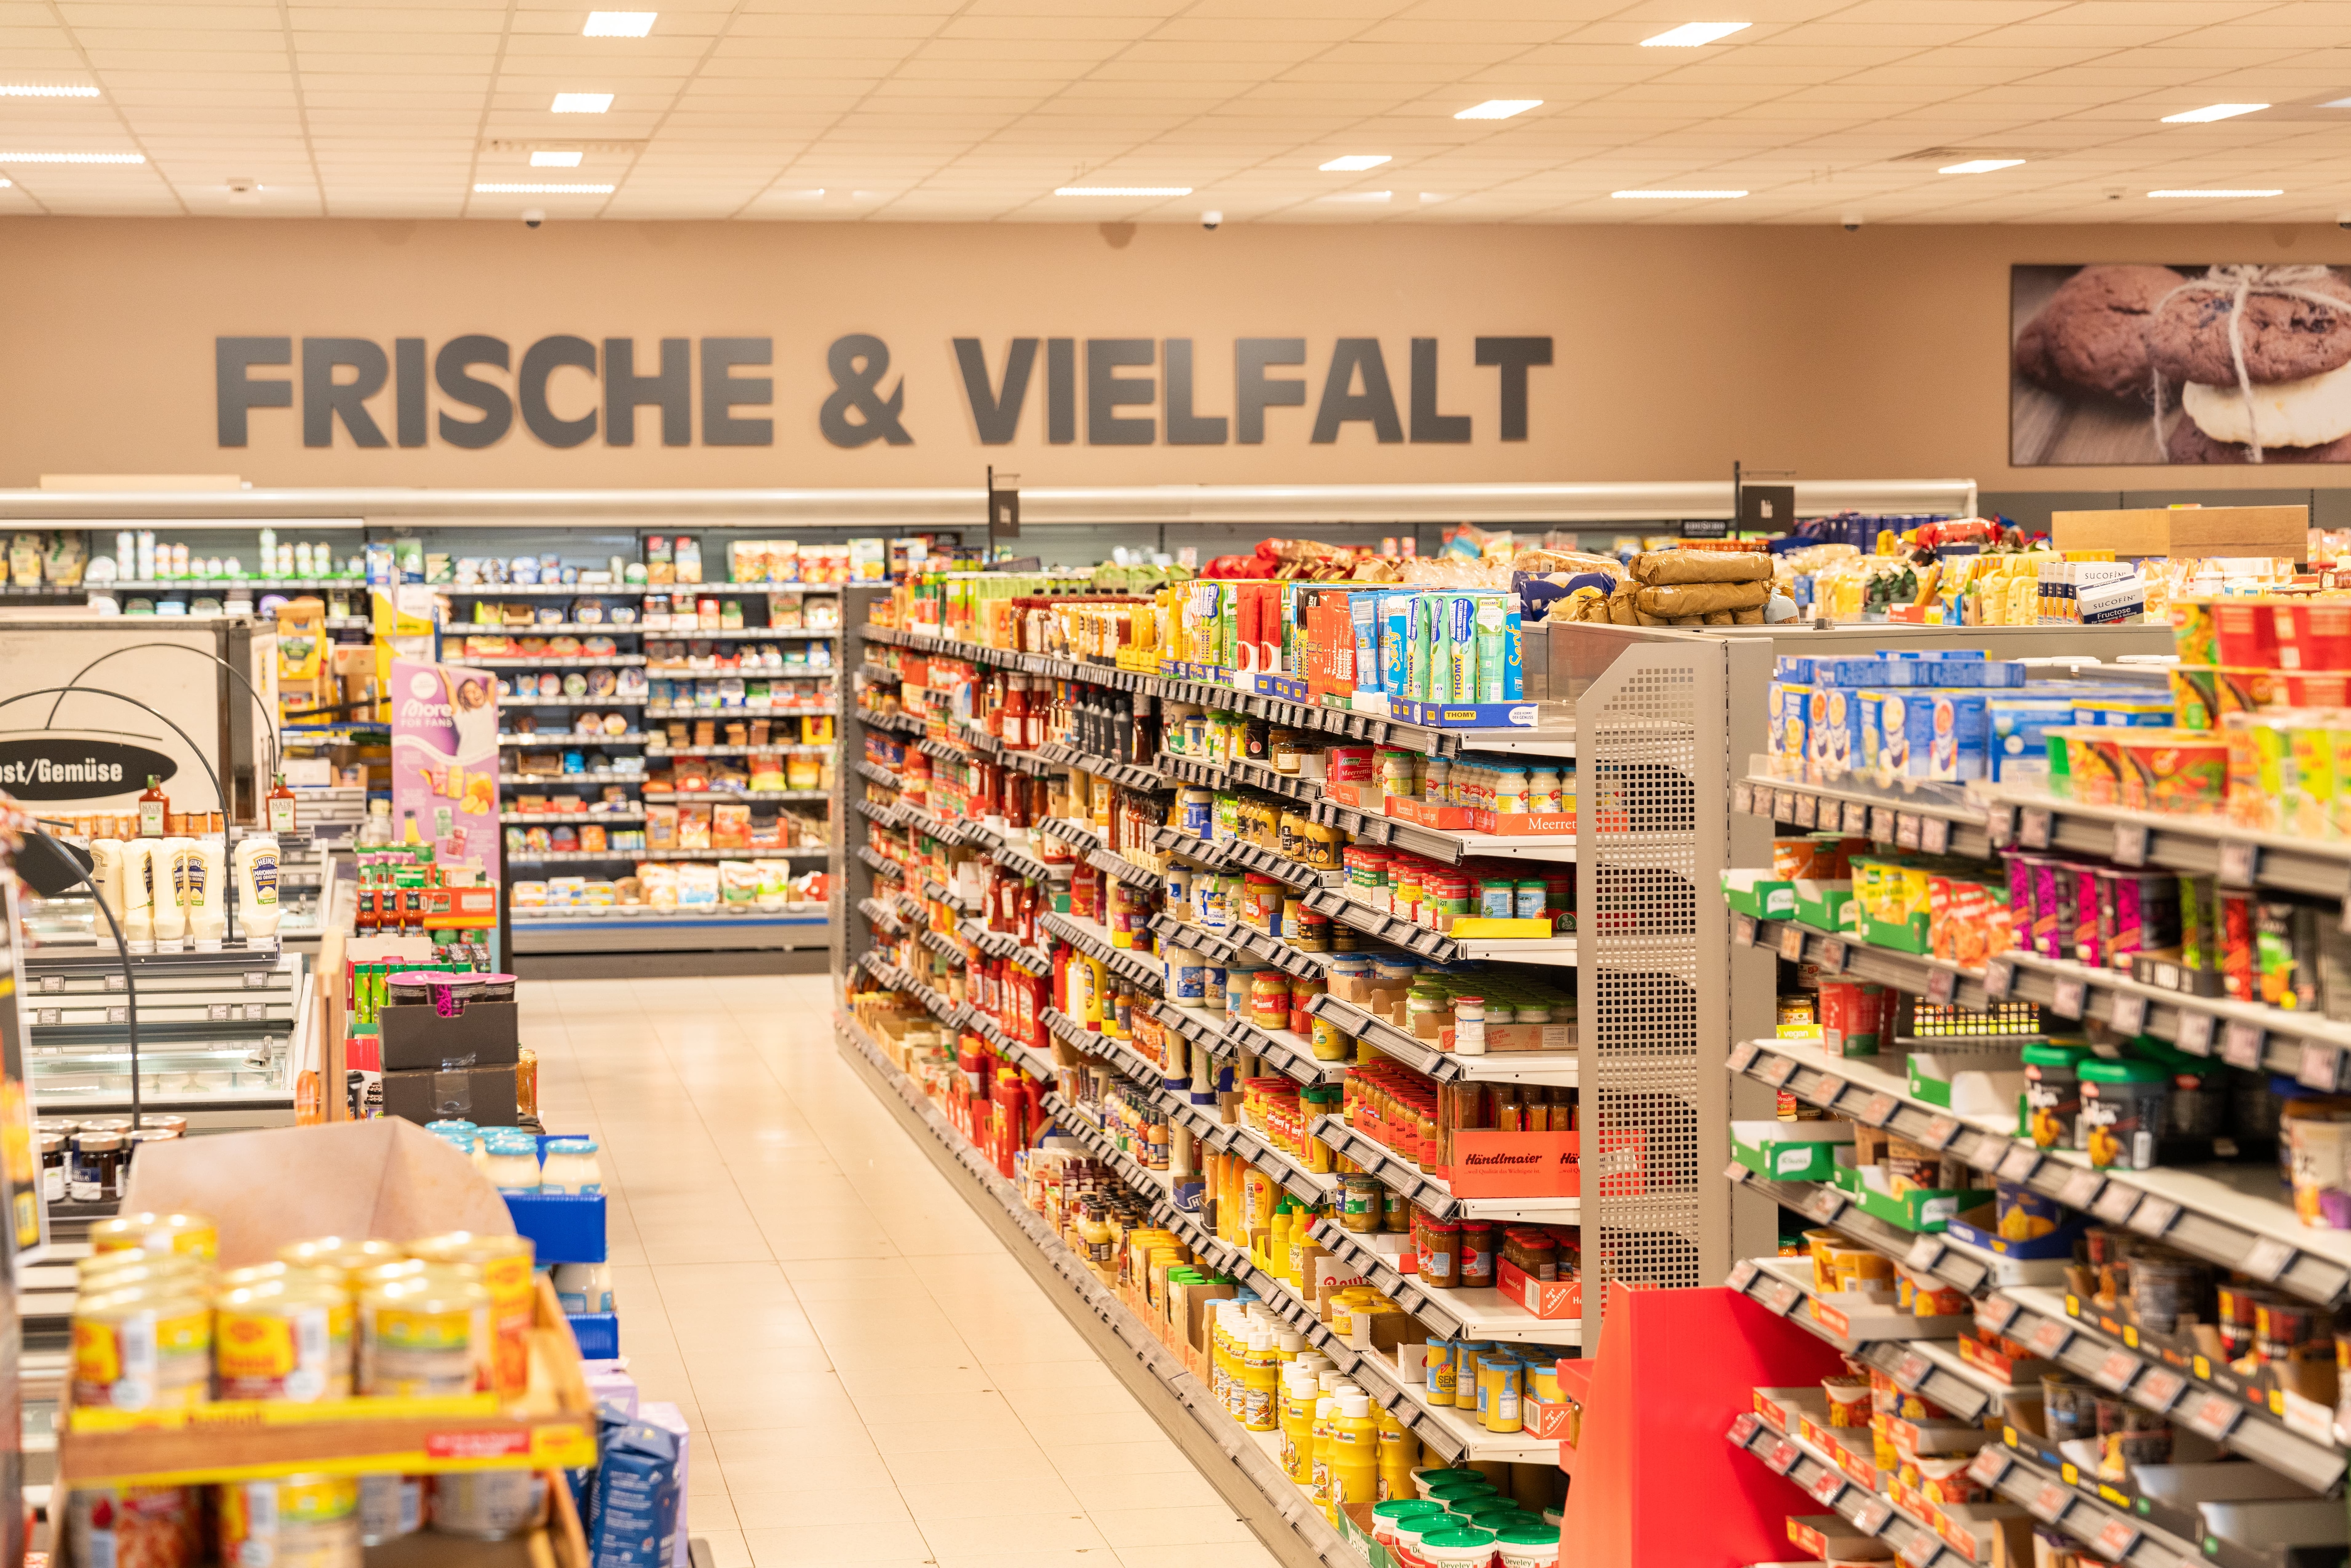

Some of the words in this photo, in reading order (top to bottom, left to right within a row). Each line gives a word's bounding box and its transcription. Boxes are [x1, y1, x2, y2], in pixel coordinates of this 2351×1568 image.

[215, 334, 773, 449] FRISCHE
[820, 333, 916, 449] &
[951, 336, 1553, 445] VIELFALT
[1207, 585, 1215, 616] REMOULADE
[2097, 607, 2131, 619] Fructose
[1345, 649, 1354, 681] Develey
[401, 698, 453, 717] More
[401, 718, 424, 728] FOR
[426, 718, 453, 728] FANS
[258, 858, 275, 866] HEINZ
[1783, 1029, 1808, 1038] vegan
[2012, 1024, 2035, 1034] vegan
[1466, 1153, 1542, 1165] Händlmaier
[1546, 1288, 1555, 1299] GUT
[1547, 1288, 1566, 1309] GÜNSTIG
[1544, 1409, 1555, 1422] GUT
[1546, 1410, 1566, 1431] GÜNSTIG
[1345, 1517, 1370, 1562] Develey
[1505, 1556, 1531, 1567] Develey
